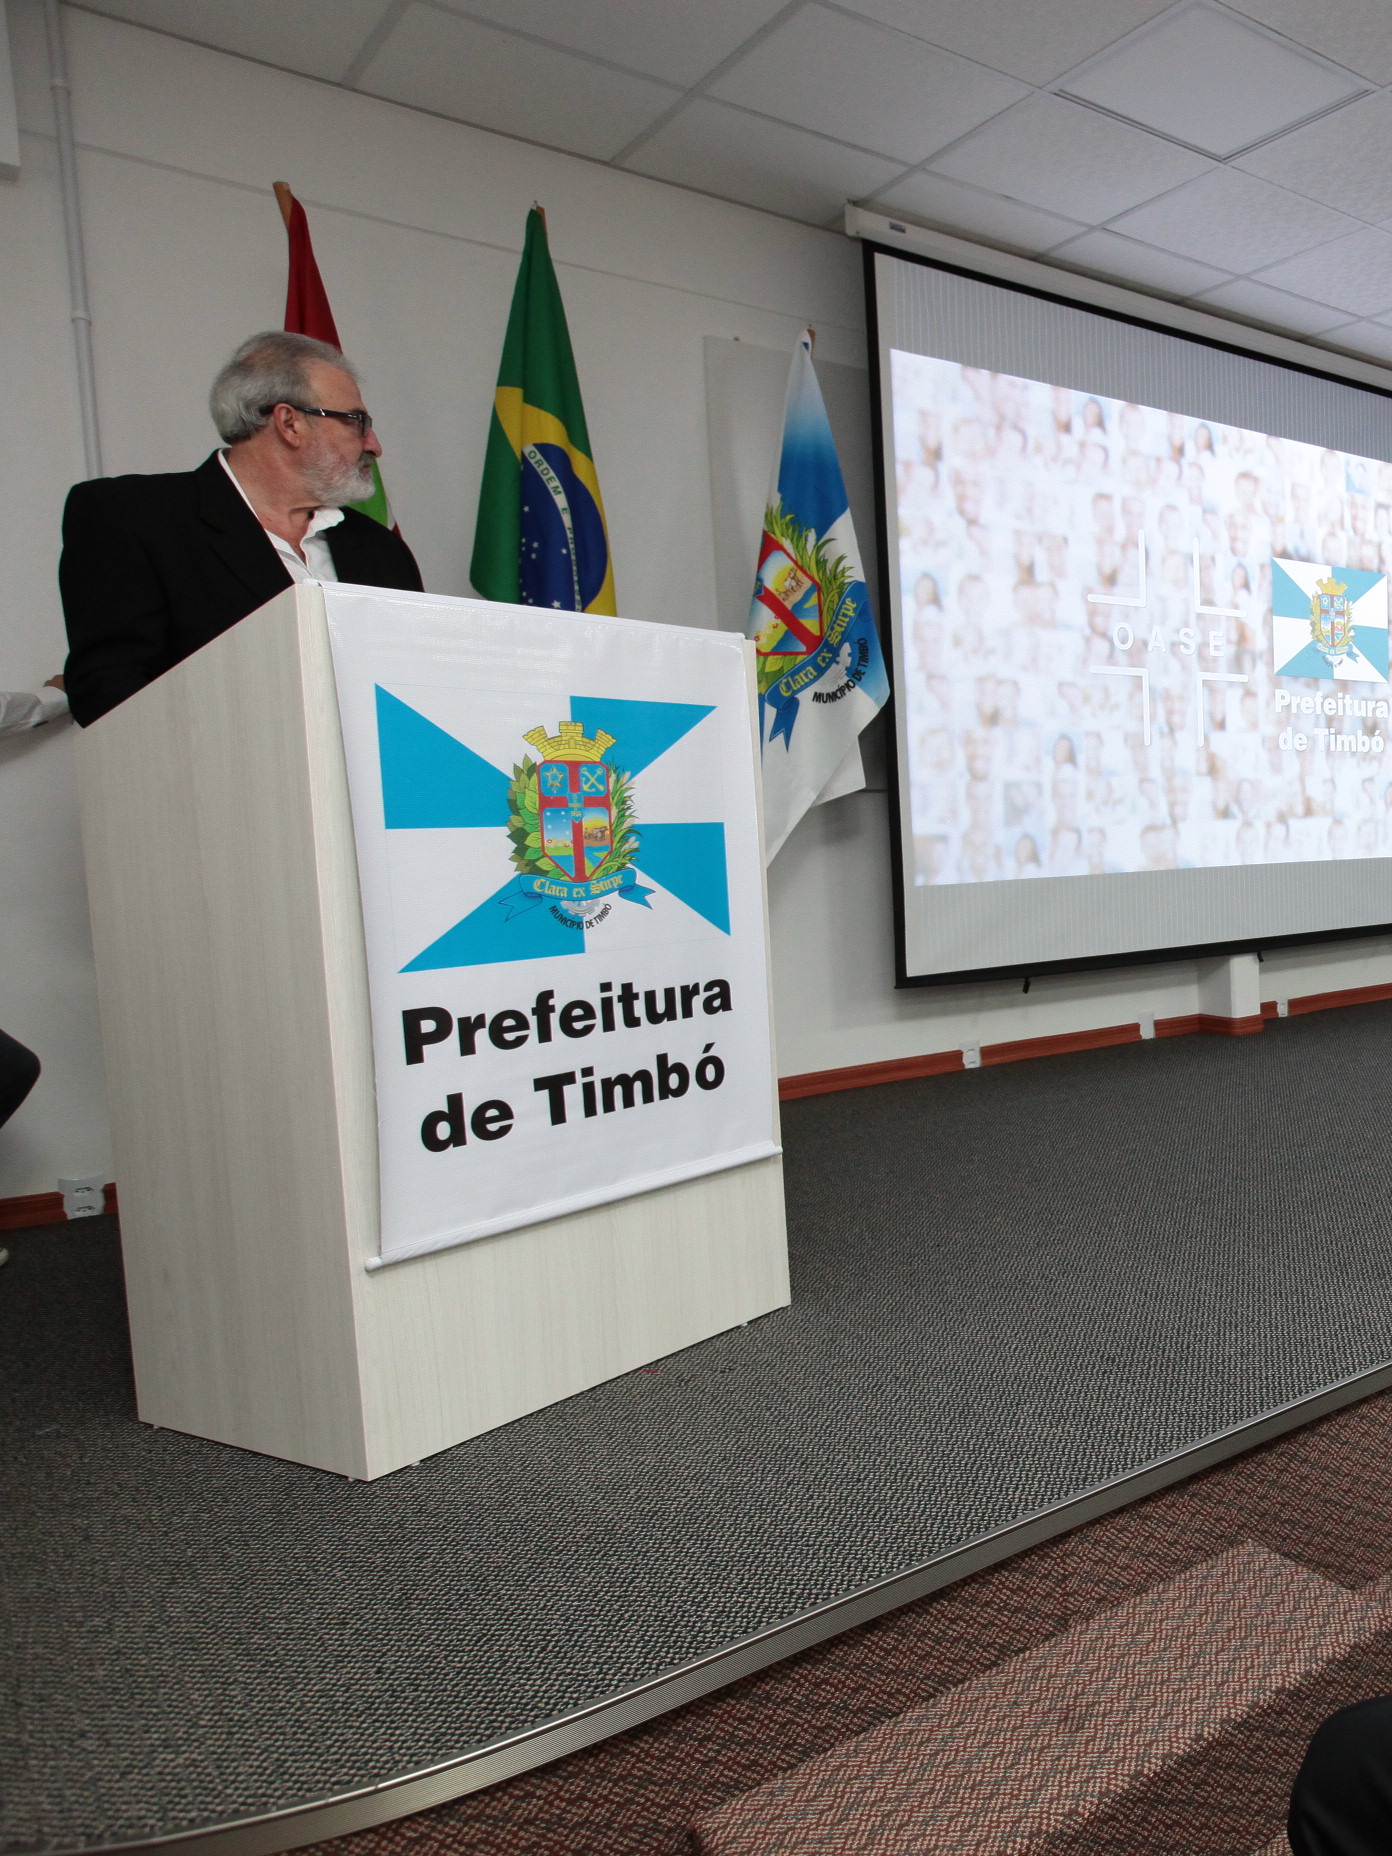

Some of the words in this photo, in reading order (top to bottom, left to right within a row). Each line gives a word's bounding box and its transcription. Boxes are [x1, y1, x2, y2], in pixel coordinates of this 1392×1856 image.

[528, 450, 562, 496] ORDEM
[855, 637, 870, 668] TIMBÓ
[1112, 621, 1225, 657] OASE
[779, 665, 818, 697] Clara
[852, 667, 866, 682] DE
[811, 679, 856, 704] MUNICÍPIO
[1275, 689, 1389, 719] Prefeitura
[1278, 727, 1307, 751] de
[1313, 729, 1385, 753] Timbó
[533, 878, 568, 898] Clara
[572, 886, 587, 898] ex
[548, 905, 584, 931] MUNICÍPIO
[585, 917, 595, 930] DE
[595, 903, 612, 926] TIMBÓ
[401, 977, 734, 1066] Prefeitura
[420, 1092, 515, 1153] de
[533, 1042, 726, 1127] Timbó
